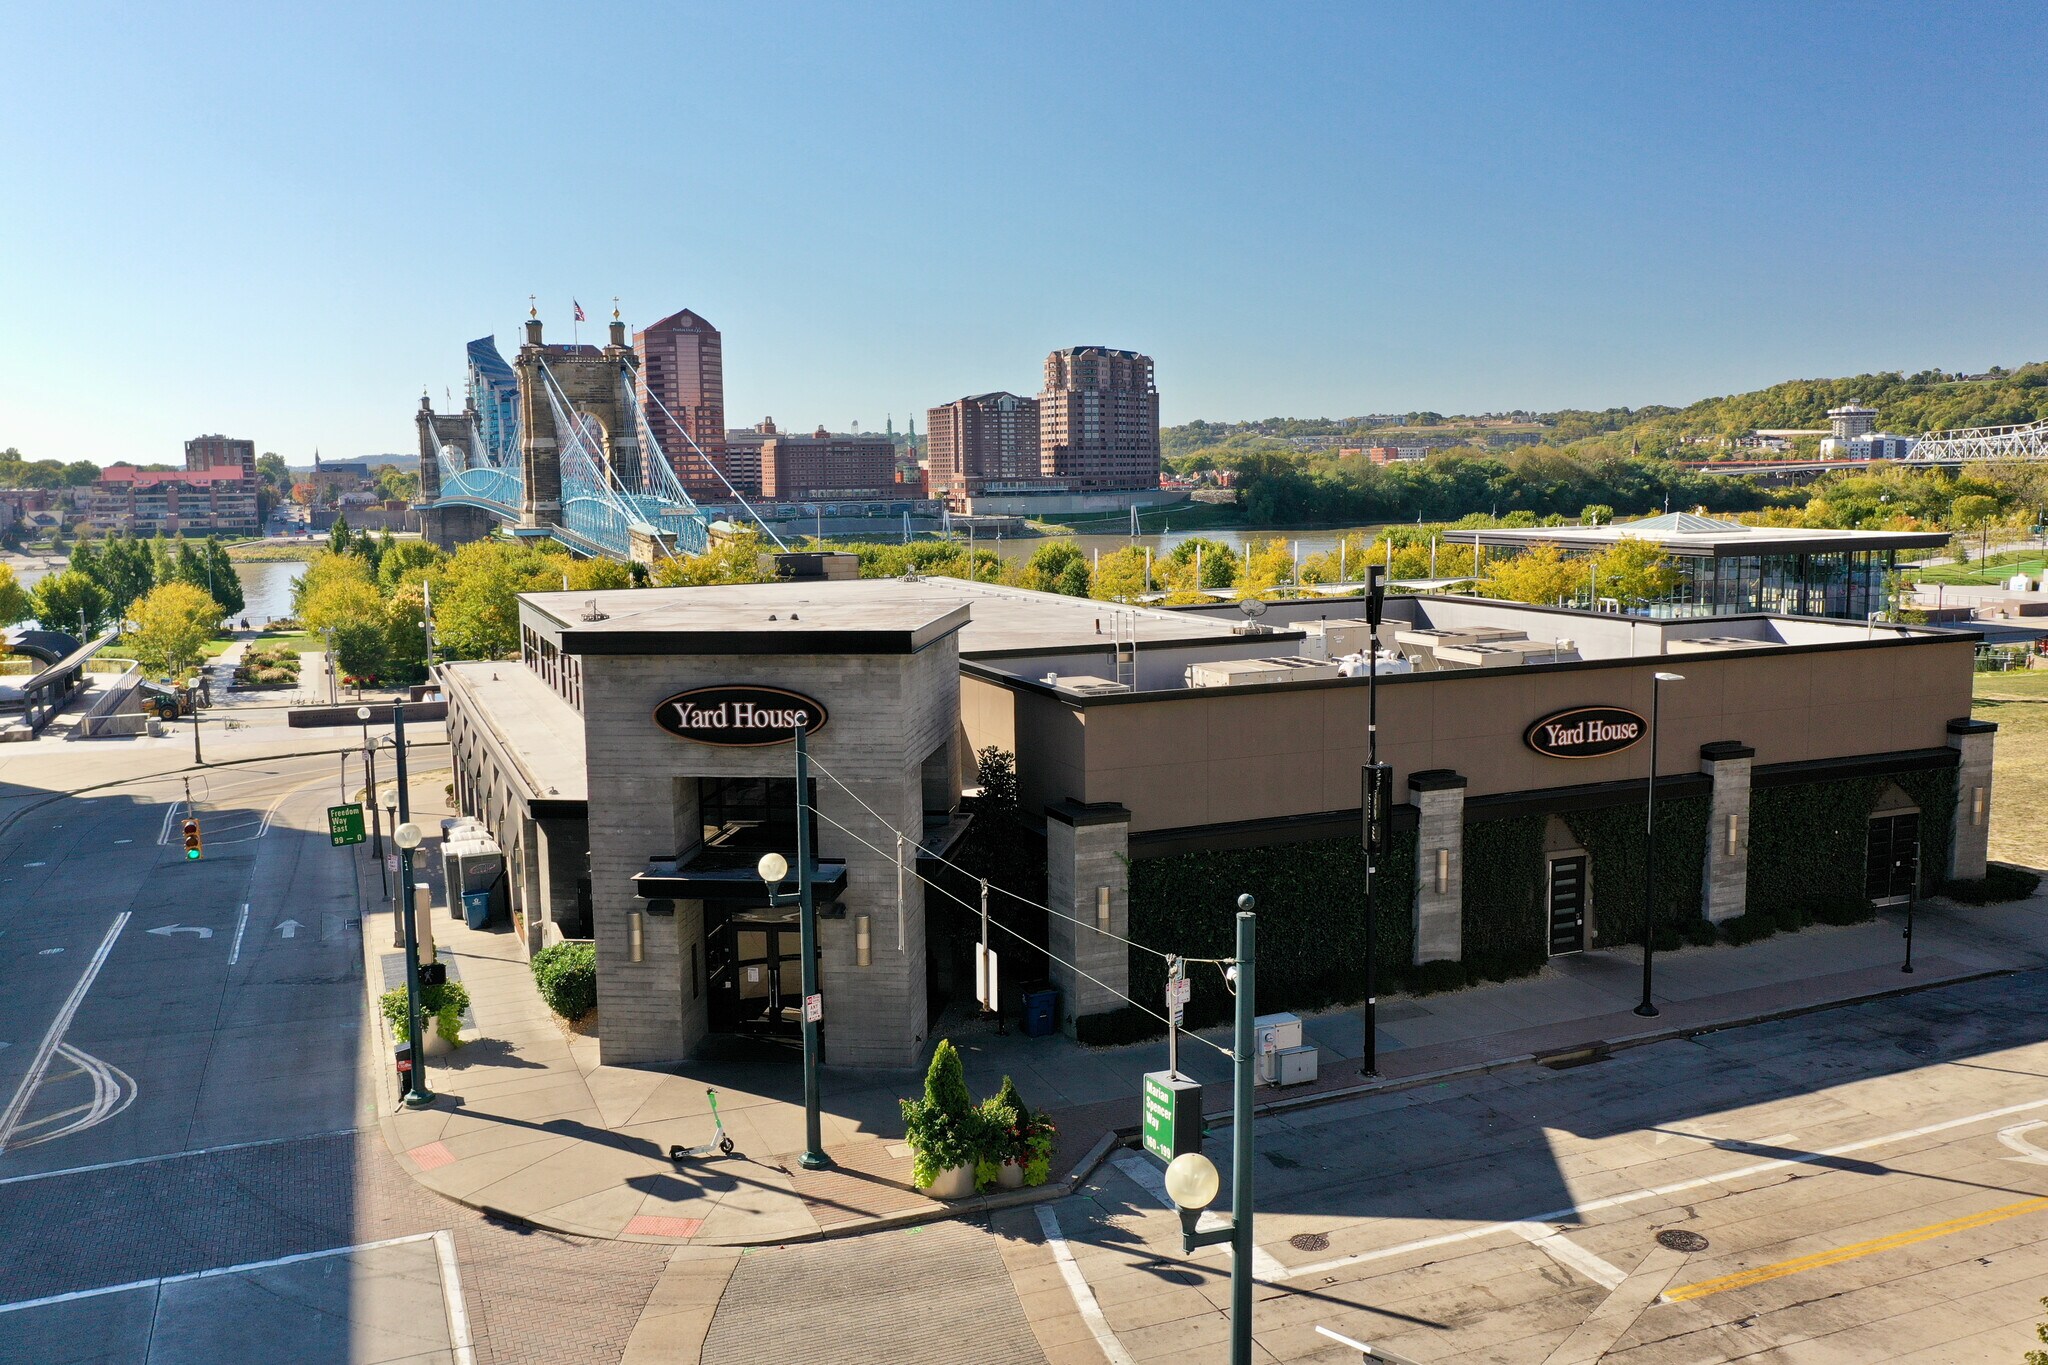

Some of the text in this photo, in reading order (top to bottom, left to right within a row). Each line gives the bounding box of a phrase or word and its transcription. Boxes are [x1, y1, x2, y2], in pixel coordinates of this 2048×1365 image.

[672, 702, 809, 729] Yard House
[1545, 720, 1639, 747] Yard House
[330, 807, 360, 817] Freedom
[331, 817, 347, 825] Way
[332, 825, 348, 833] East
[1146, 1080, 1168, 1104] Marian
[1146, 1095, 1172, 1121] Spencer
[1146, 1110, 1159, 1131] Way
